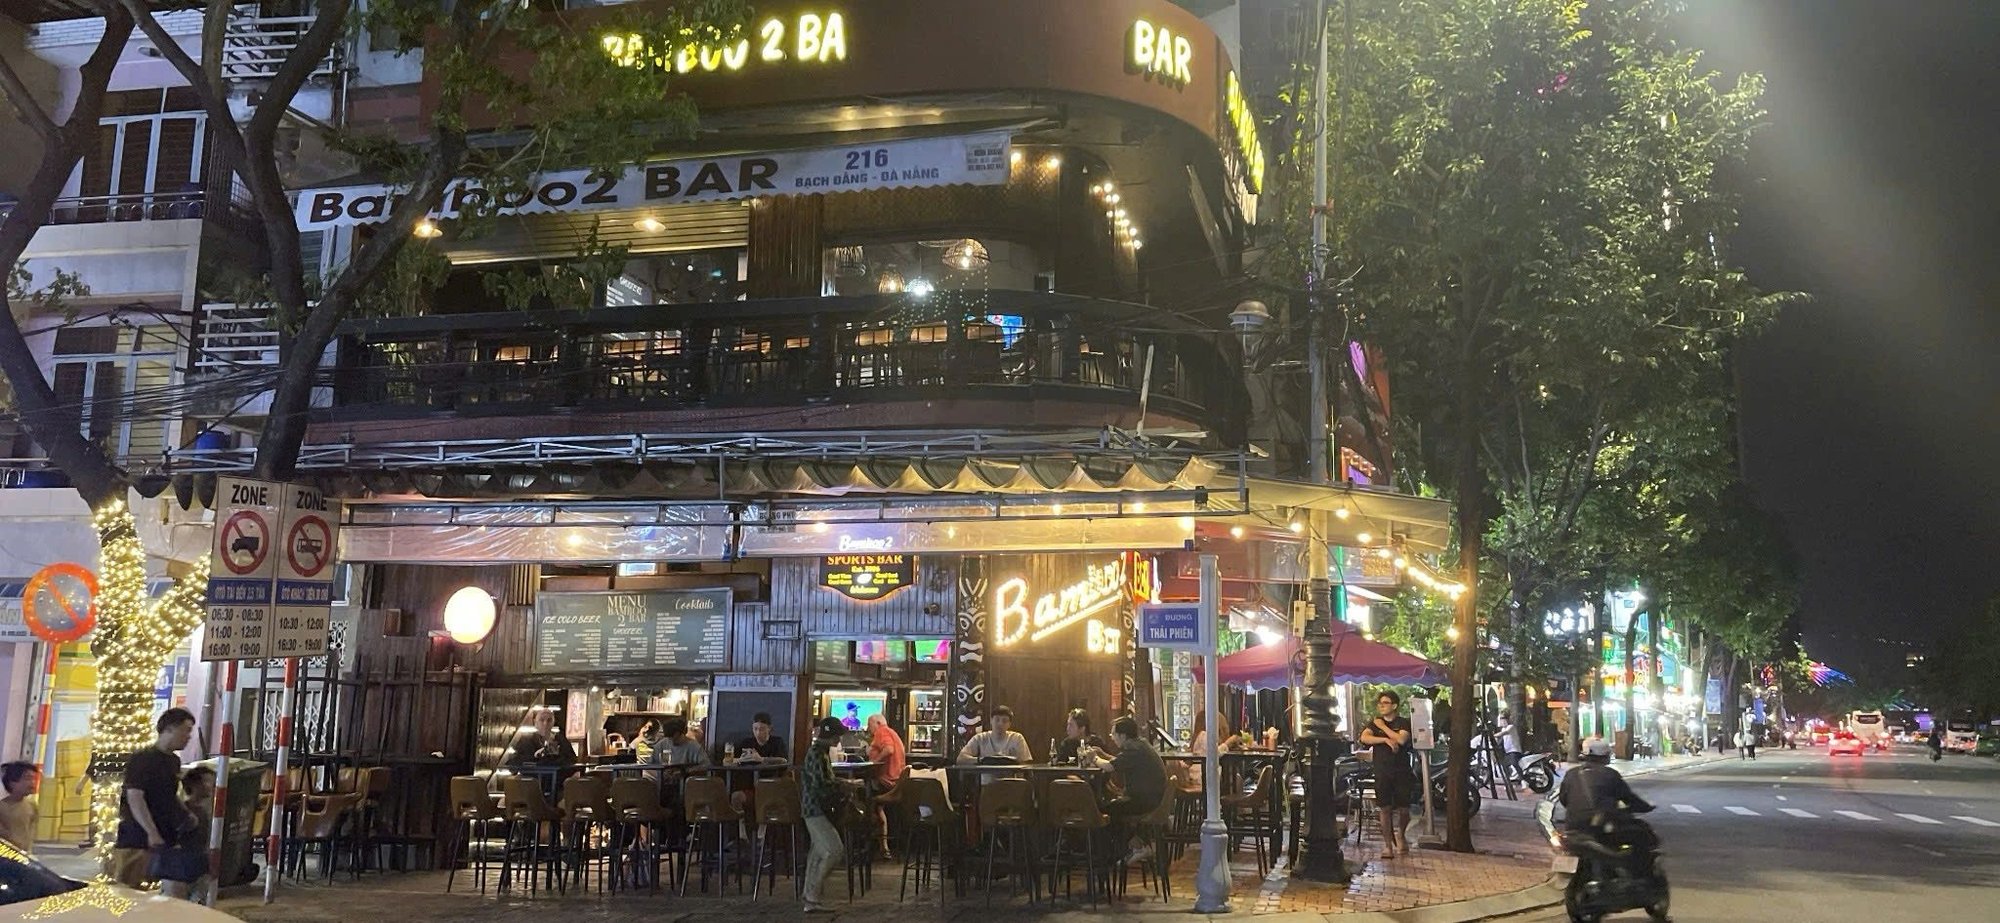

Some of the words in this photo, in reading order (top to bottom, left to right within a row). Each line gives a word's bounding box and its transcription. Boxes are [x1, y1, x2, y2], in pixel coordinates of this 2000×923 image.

[760, 18, 785, 62] 2
[797, 12, 846, 63] BA
[1134, 19, 1192, 85] BAR
[845, 148, 889, 170] 216
[645, 157, 779, 200] BAR
[231, 484, 268, 506] ZONE
[296, 490, 328, 511] ZONE
[608, 594, 647, 608] MENU
[241, 608, 264, 621] 08:30
[578, 614, 601, 624] BEER
[617, 613, 626, 627] 2
[279, 617, 299, 630] 10:30
[306, 617, 324, 630] 12:00
[210, 626, 232, 639] 11:00
[241, 626, 262, 638] 12:00
[208, 643, 231, 656] 16:00
[239, 643, 261, 656] 19:00
[277, 639, 297, 651] 16:30
[304, 639, 322, 650] 19:00
